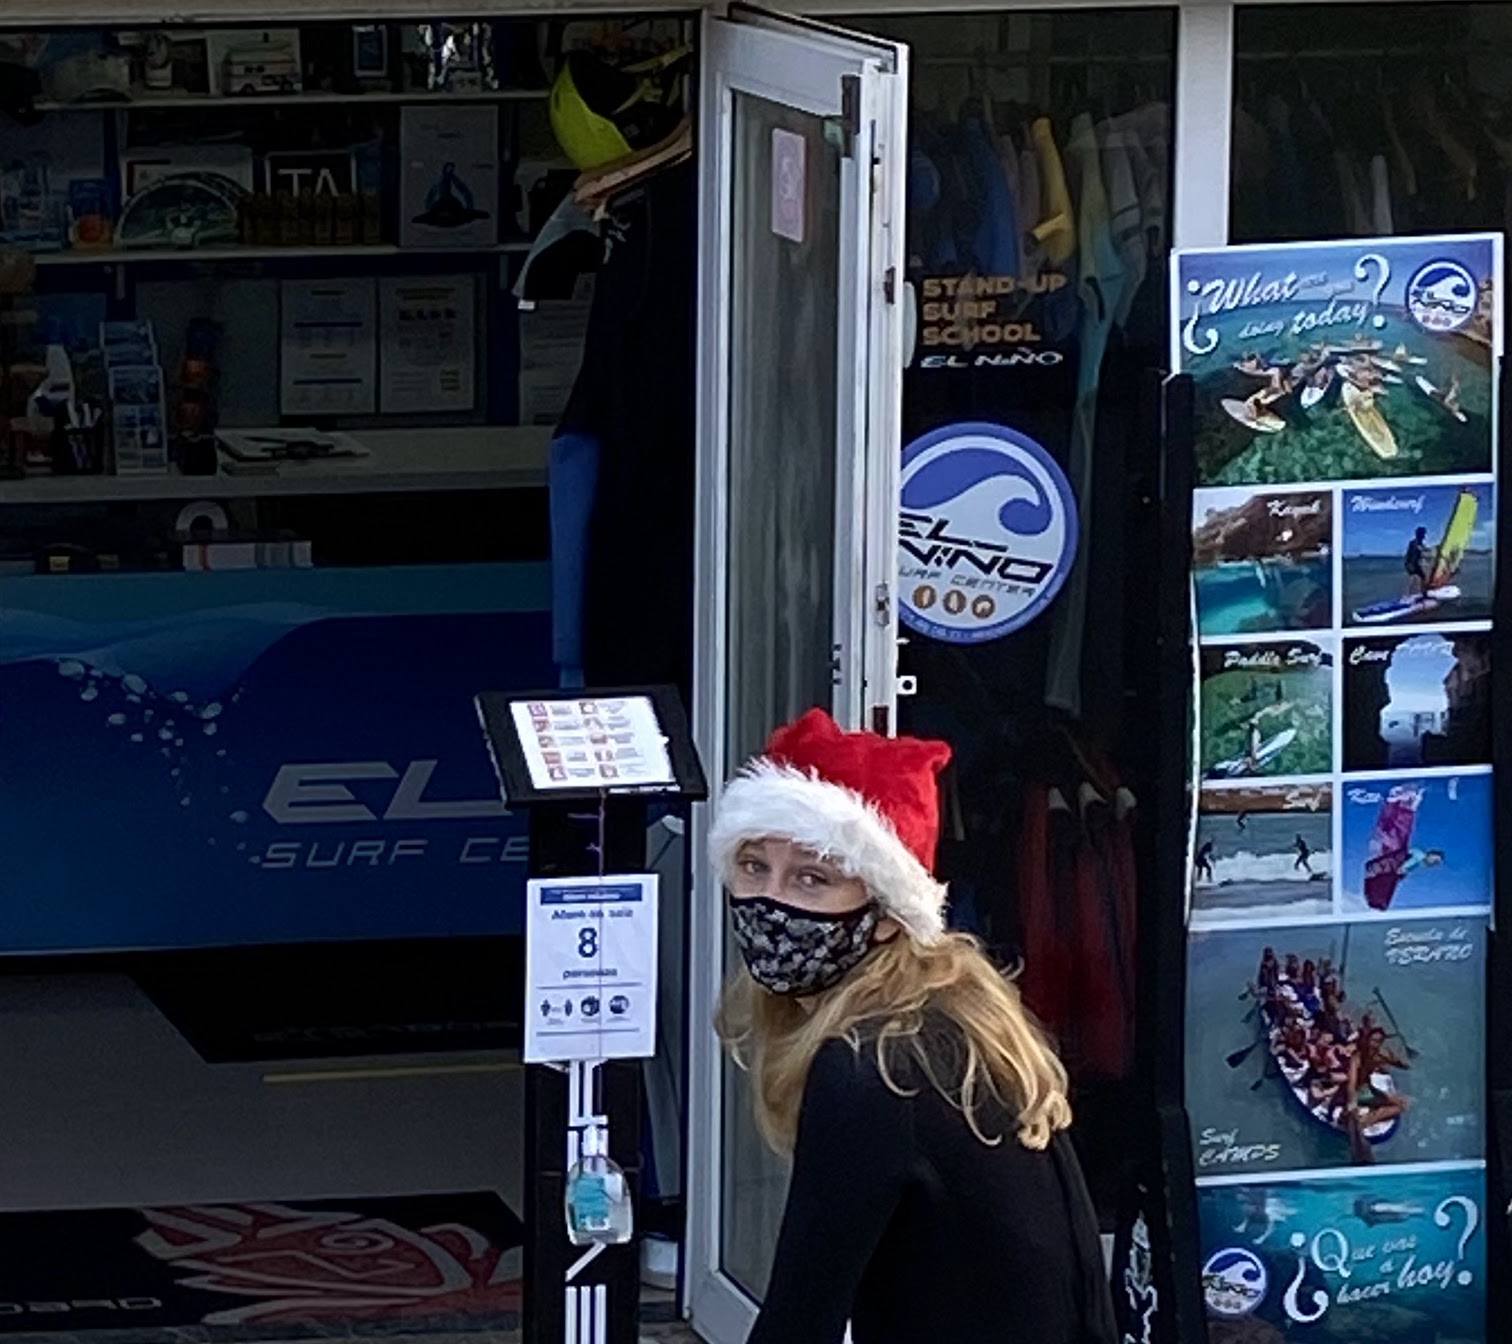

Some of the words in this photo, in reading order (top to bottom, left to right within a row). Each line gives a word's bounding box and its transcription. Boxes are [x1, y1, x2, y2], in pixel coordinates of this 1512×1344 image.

[922, 273, 1068, 298] STAND-UP
[922, 301, 998, 321] SURF
[922, 323, 1042, 346] SCHOOL
[899, 565, 942, 580] URF
[261, 759, 514, 823] EL
[261, 839, 429, 869] SURF
[578, 926, 599, 958] 8
